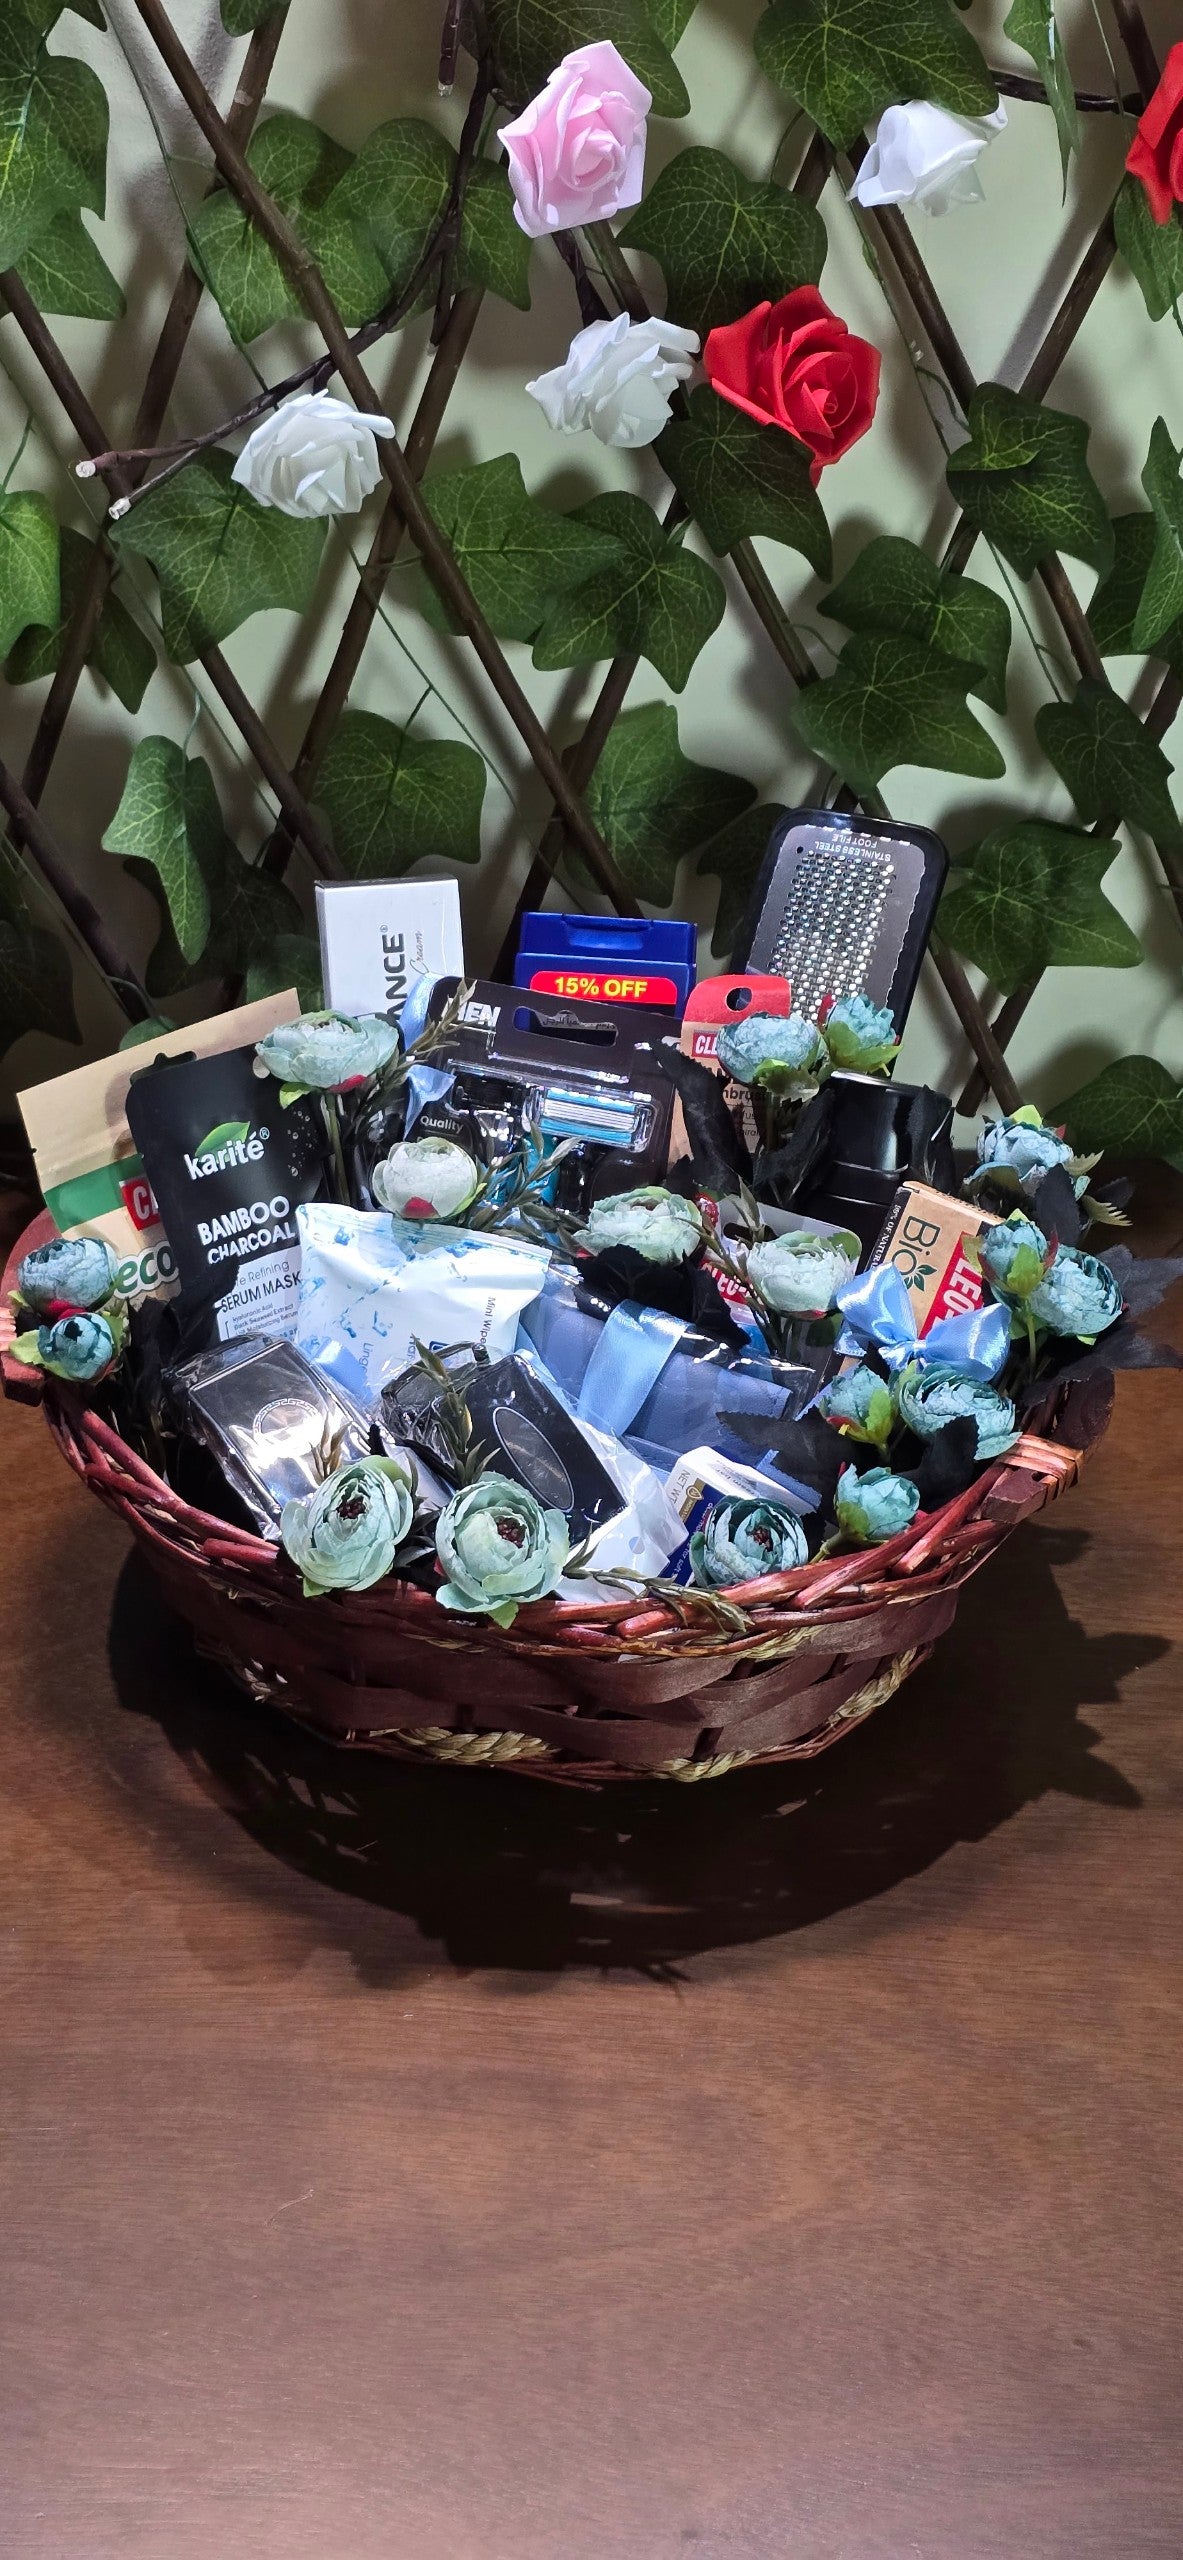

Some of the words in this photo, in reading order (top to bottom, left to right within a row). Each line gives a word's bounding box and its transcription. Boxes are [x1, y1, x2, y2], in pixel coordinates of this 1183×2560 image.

[814, 841, 842, 853] STEEL
[554, 976, 600, 996] 15%
[603, 979, 648, 998] OFF
[420, 1115, 464, 1134] Quality
[183, 1130, 265, 1180] karité
[197, 1195, 290, 1246] BAMBOO
[207, 1221, 296, 1265] CHARCOAL
[247, 1261, 290, 1281] Refining
[220, 1286, 262, 1313] SERUM
[262, 1270, 302, 1297] MASK
